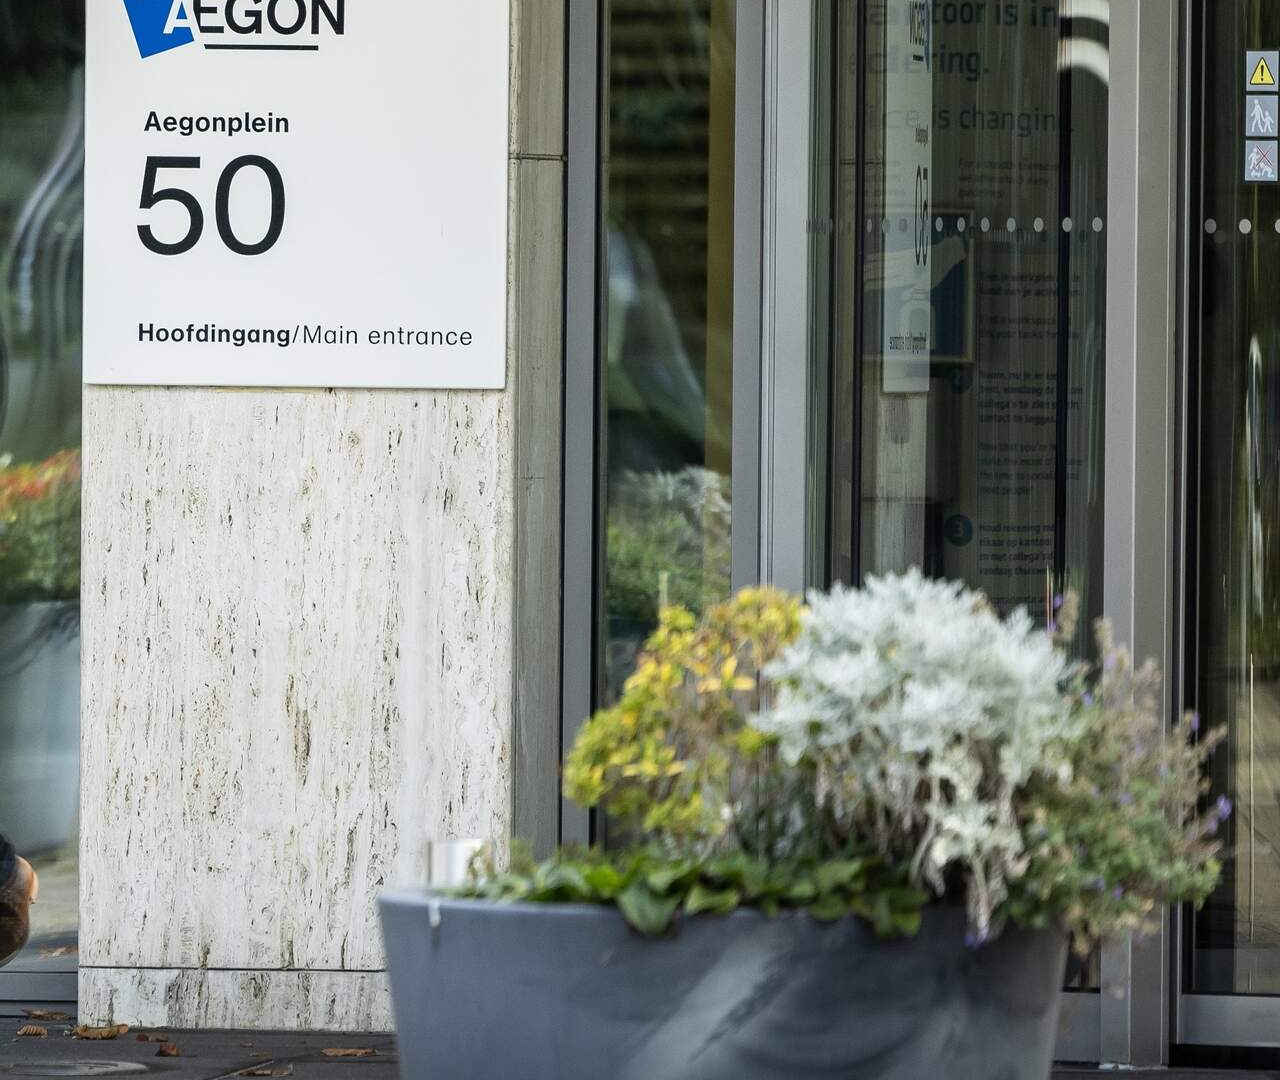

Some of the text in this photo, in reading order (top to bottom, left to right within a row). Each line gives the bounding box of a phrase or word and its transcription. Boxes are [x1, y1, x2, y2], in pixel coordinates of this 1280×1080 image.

[143, 110, 290, 137] Aegonplein
[136, 154, 286, 256] 50
[137, 323, 474, 348] Hoofdingang/Main entrance
